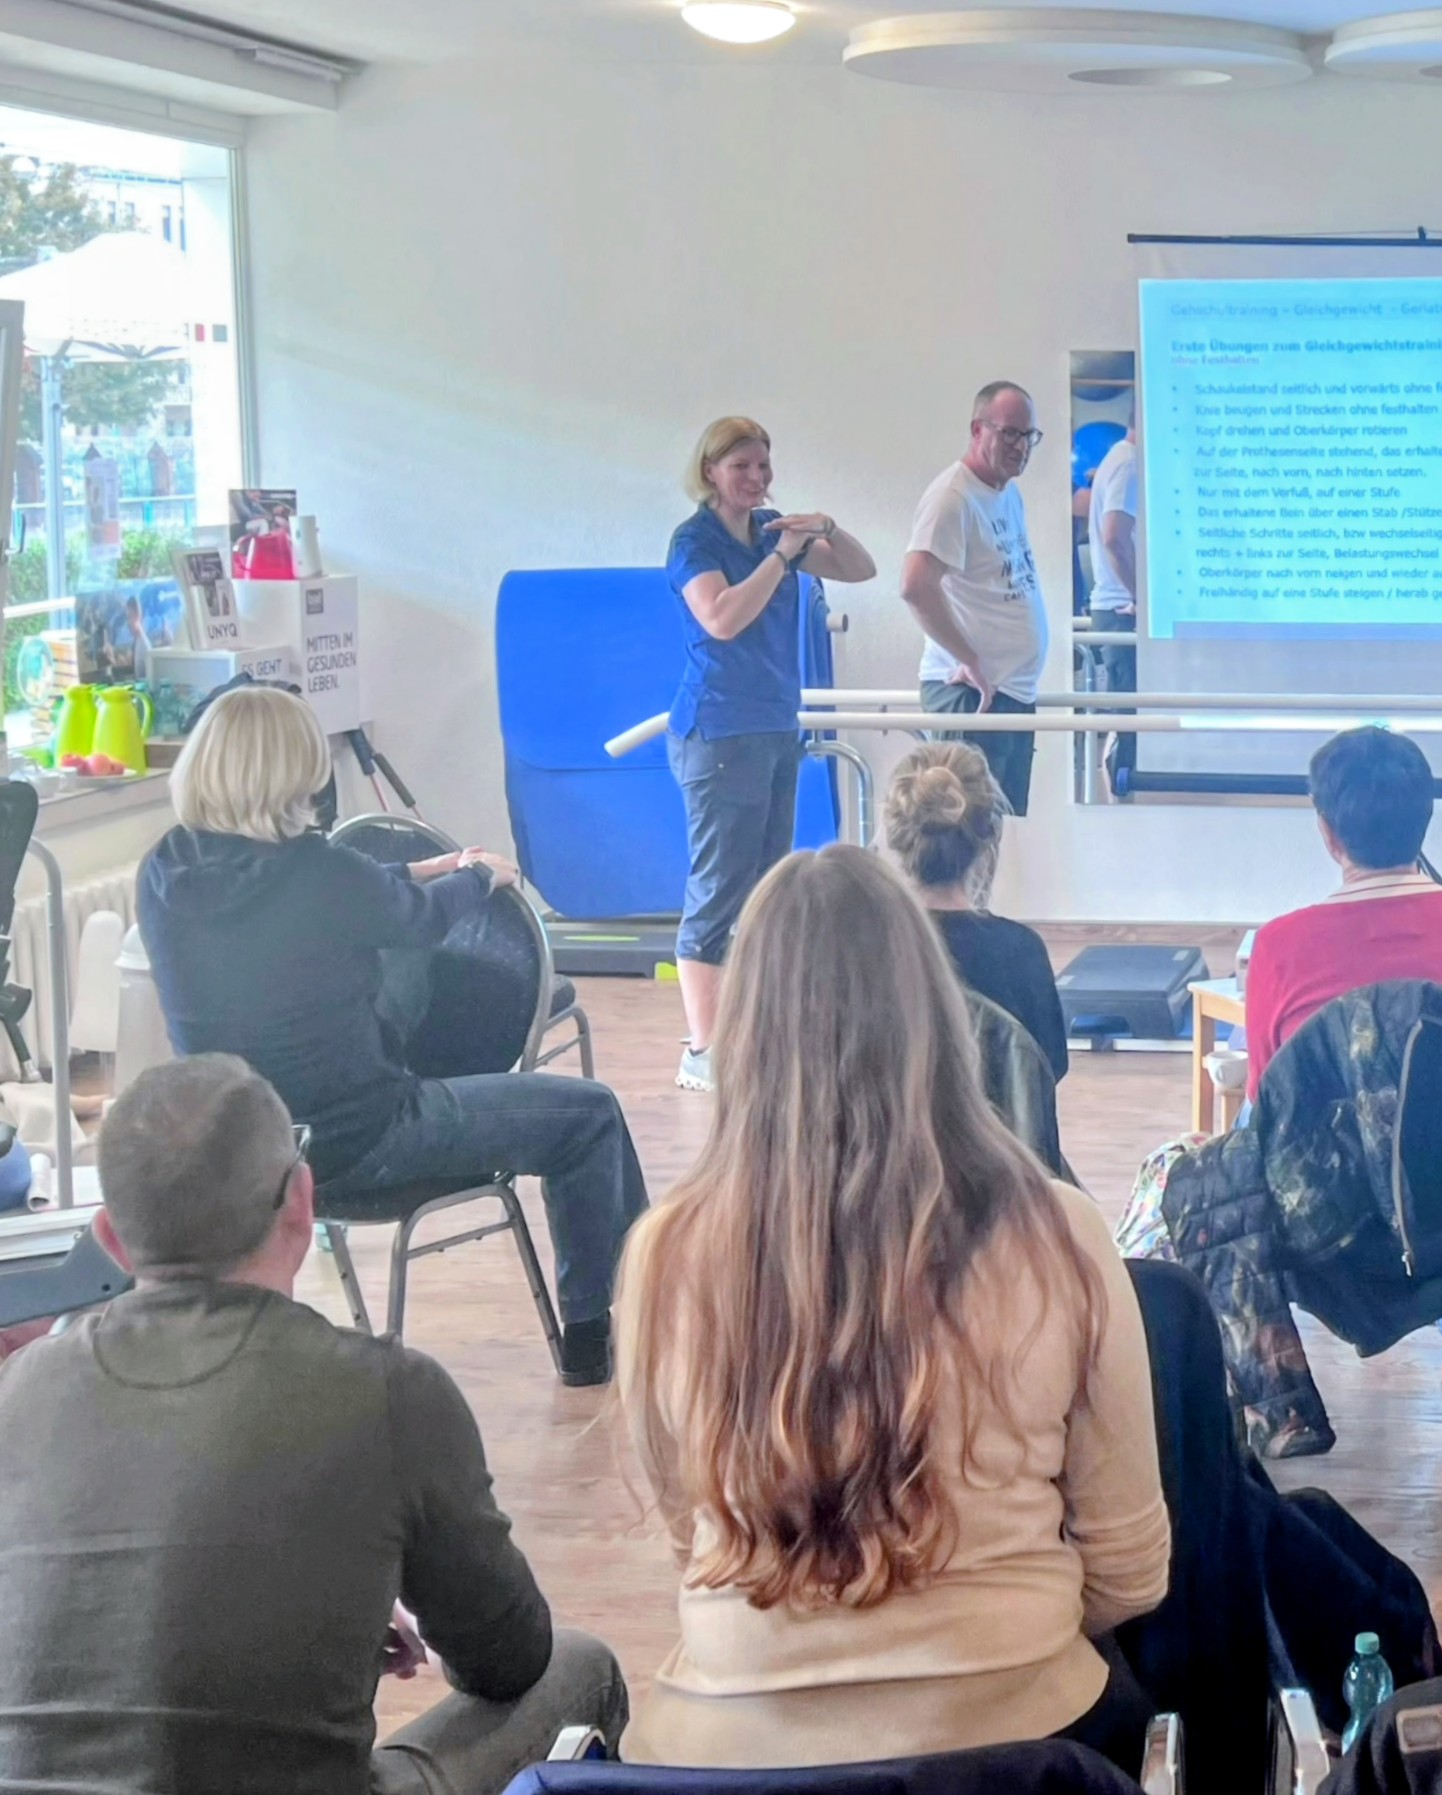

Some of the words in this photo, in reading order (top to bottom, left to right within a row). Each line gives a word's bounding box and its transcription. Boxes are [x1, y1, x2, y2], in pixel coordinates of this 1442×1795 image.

[1293, 303, 1383, 318] Gleichgewicht
[1171, 339, 1206, 351] Erste
[1209, 338, 1268, 353] Übungen
[1273, 342, 1300, 351] zum
[1325, 382, 1347, 394] und
[1403, 382, 1433, 394] ohne
[1224, 405, 1267, 418] beugen
[1270, 405, 1292, 415] und
[1295, 404, 1346, 415] Strecken
[1349, 404, 1378, 415] ohne
[1381, 403, 1438, 415] festhalten
[1225, 425, 1265, 436] drehen
[1268, 425, 1290, 436] und
[1293, 425, 1359, 438] Oberkörper
[1196, 446, 1216, 457] Auf
[1219, 446, 1238, 457] der
[1381, 446, 1402, 457] das
[1193, 468, 1212, 478] zur
[1252, 467, 1279, 478] nach
[1316, 467, 1343, 478] nach
[1346, 467, 1382, 478] hinten
[1197, 486, 1218, 498] Nur
[1222, 487, 1241, 498] mit
[1243, 487, 1269, 498] dem
[1316, 486, 1336, 498] auf
[1338, 487, 1367, 498] einer
[1370, 486, 1401, 498] Stufe
[1197, 506, 1220, 518] Das
[1307, 506, 1335, 518] über
[1337, 507, 1369, 518] einen
[1371, 506, 1398, 518] Stab
[1249, 528, 1294, 539] Schritte
[1196, 547, 1231, 558] rechts
[1246, 548, 1273, 558] links
[1276, 550, 1295, 558] zur
[1198, 567, 1263, 580] Oberkörper
[1266, 568, 1294, 578] nach
[1325, 568, 1363, 581] neigen
[1366, 568, 1388, 578] und
[1391, 568, 1429, 578] wieder
[1261, 588, 1280, 598] auf
[1282, 588, 1307, 598] eine
[1309, 587, 1340, 598] Stufe
[1343, 588, 1385, 601] steigen
[1395, 587, 1429, 599] herab
[207, 622, 238, 640] UNYQ
[306, 633, 342, 653] MITTEN
[343, 631, 353, 649] IM
[307, 651, 357, 674] GESUNDEN
